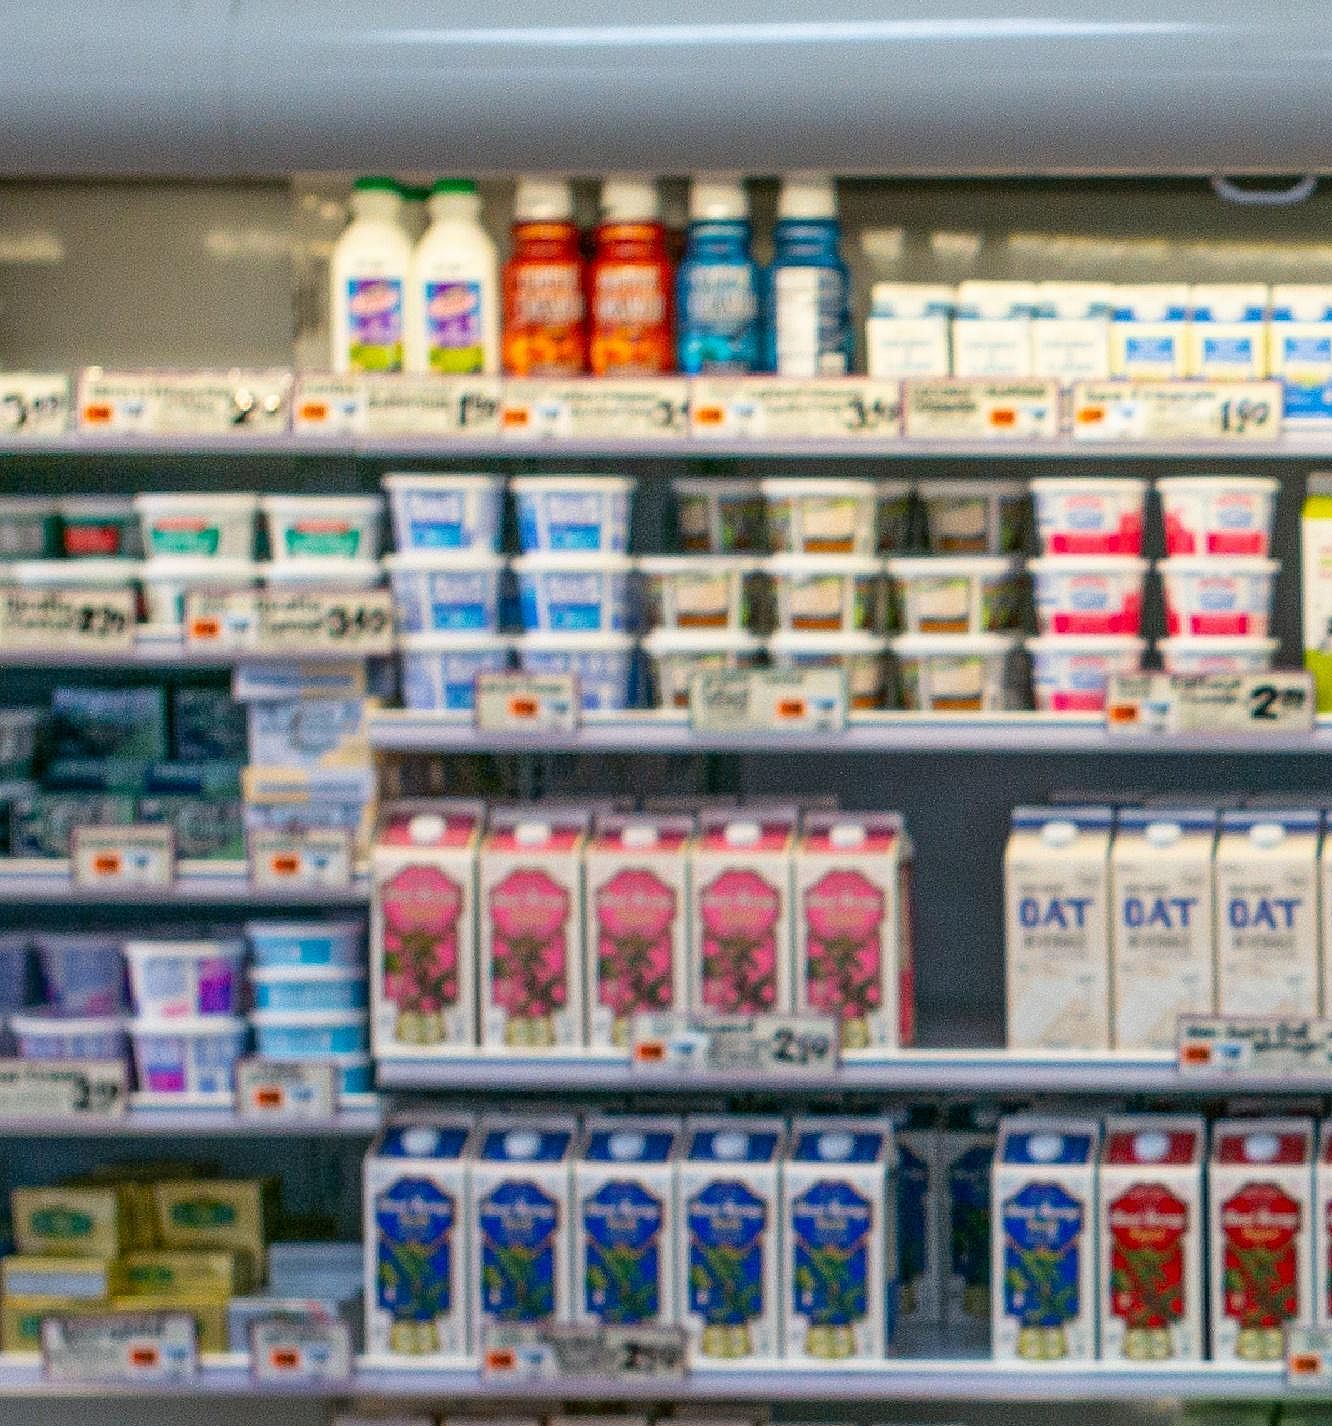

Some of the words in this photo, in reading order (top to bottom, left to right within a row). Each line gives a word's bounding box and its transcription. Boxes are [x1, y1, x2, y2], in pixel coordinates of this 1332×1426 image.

[1019, 897, 1094, 930] OAT
[1124, 897, 1199, 930] OAT
[1229, 897, 1303, 930] OAT
